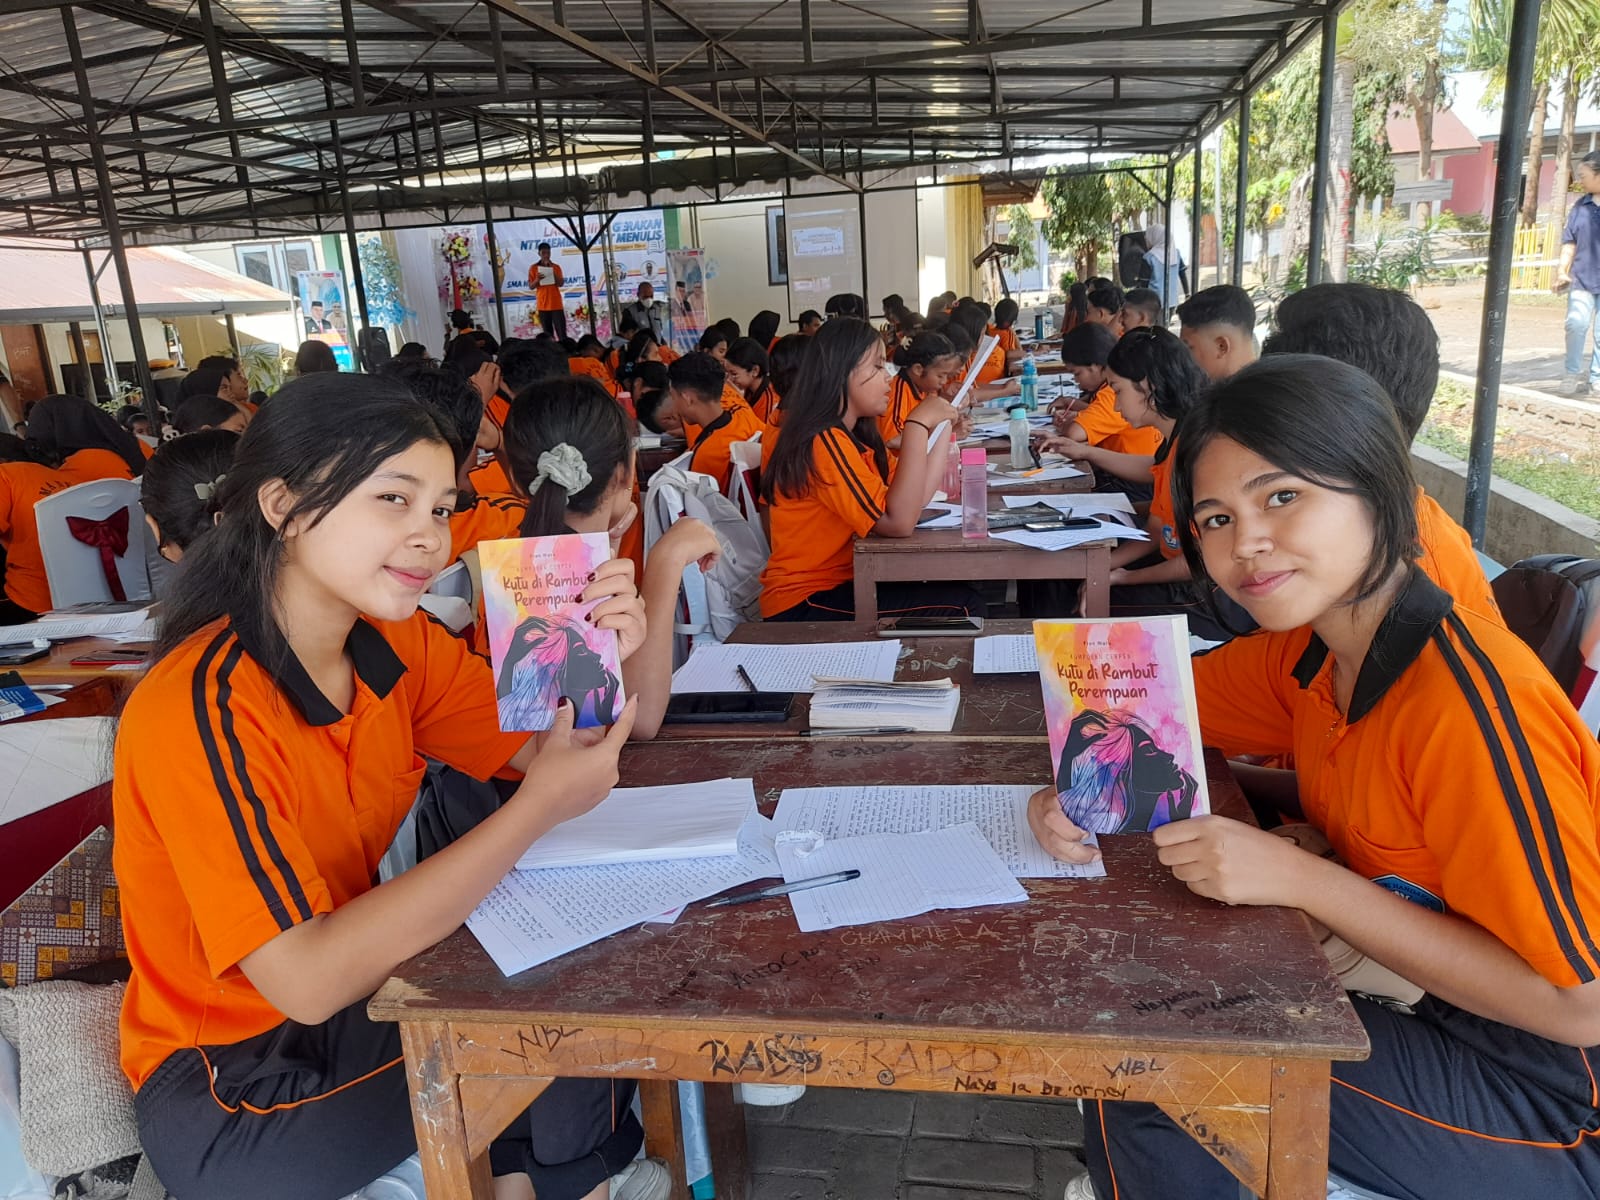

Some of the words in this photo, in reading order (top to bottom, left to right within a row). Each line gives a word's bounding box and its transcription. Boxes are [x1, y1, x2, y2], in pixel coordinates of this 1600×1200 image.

[616, 230, 662, 243] MENULIS
[503, 575, 528, 591] Kutu
[532, 574, 542, 589] di
[1057, 663, 1083, 678] Kutu
[1087, 664, 1099, 680] di
[1101, 663, 1159, 680] Rambut
[1069, 681, 1148, 704] Perempuan
